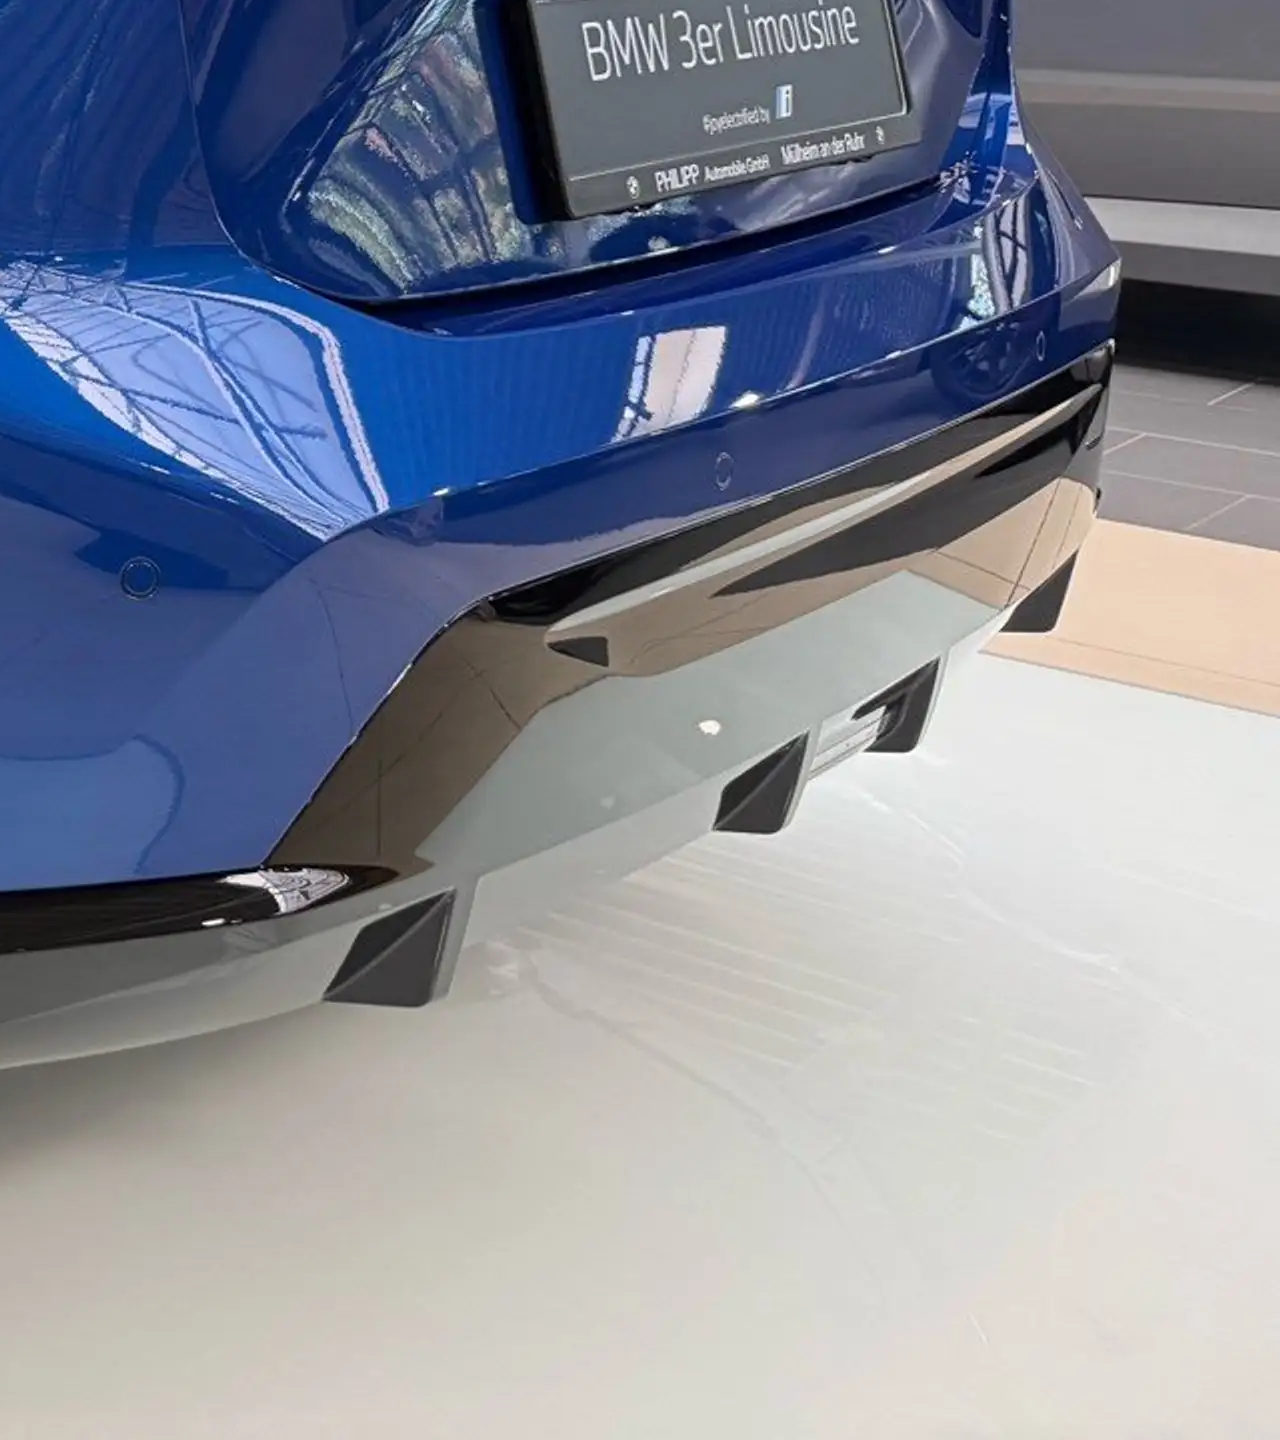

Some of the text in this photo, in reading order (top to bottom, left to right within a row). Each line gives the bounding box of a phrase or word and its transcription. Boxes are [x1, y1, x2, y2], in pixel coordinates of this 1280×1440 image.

[582, 13, 669, 82] BMW
[672, 10, 724, 70] 3er
[653, 163, 700, 193] PHILIPP
